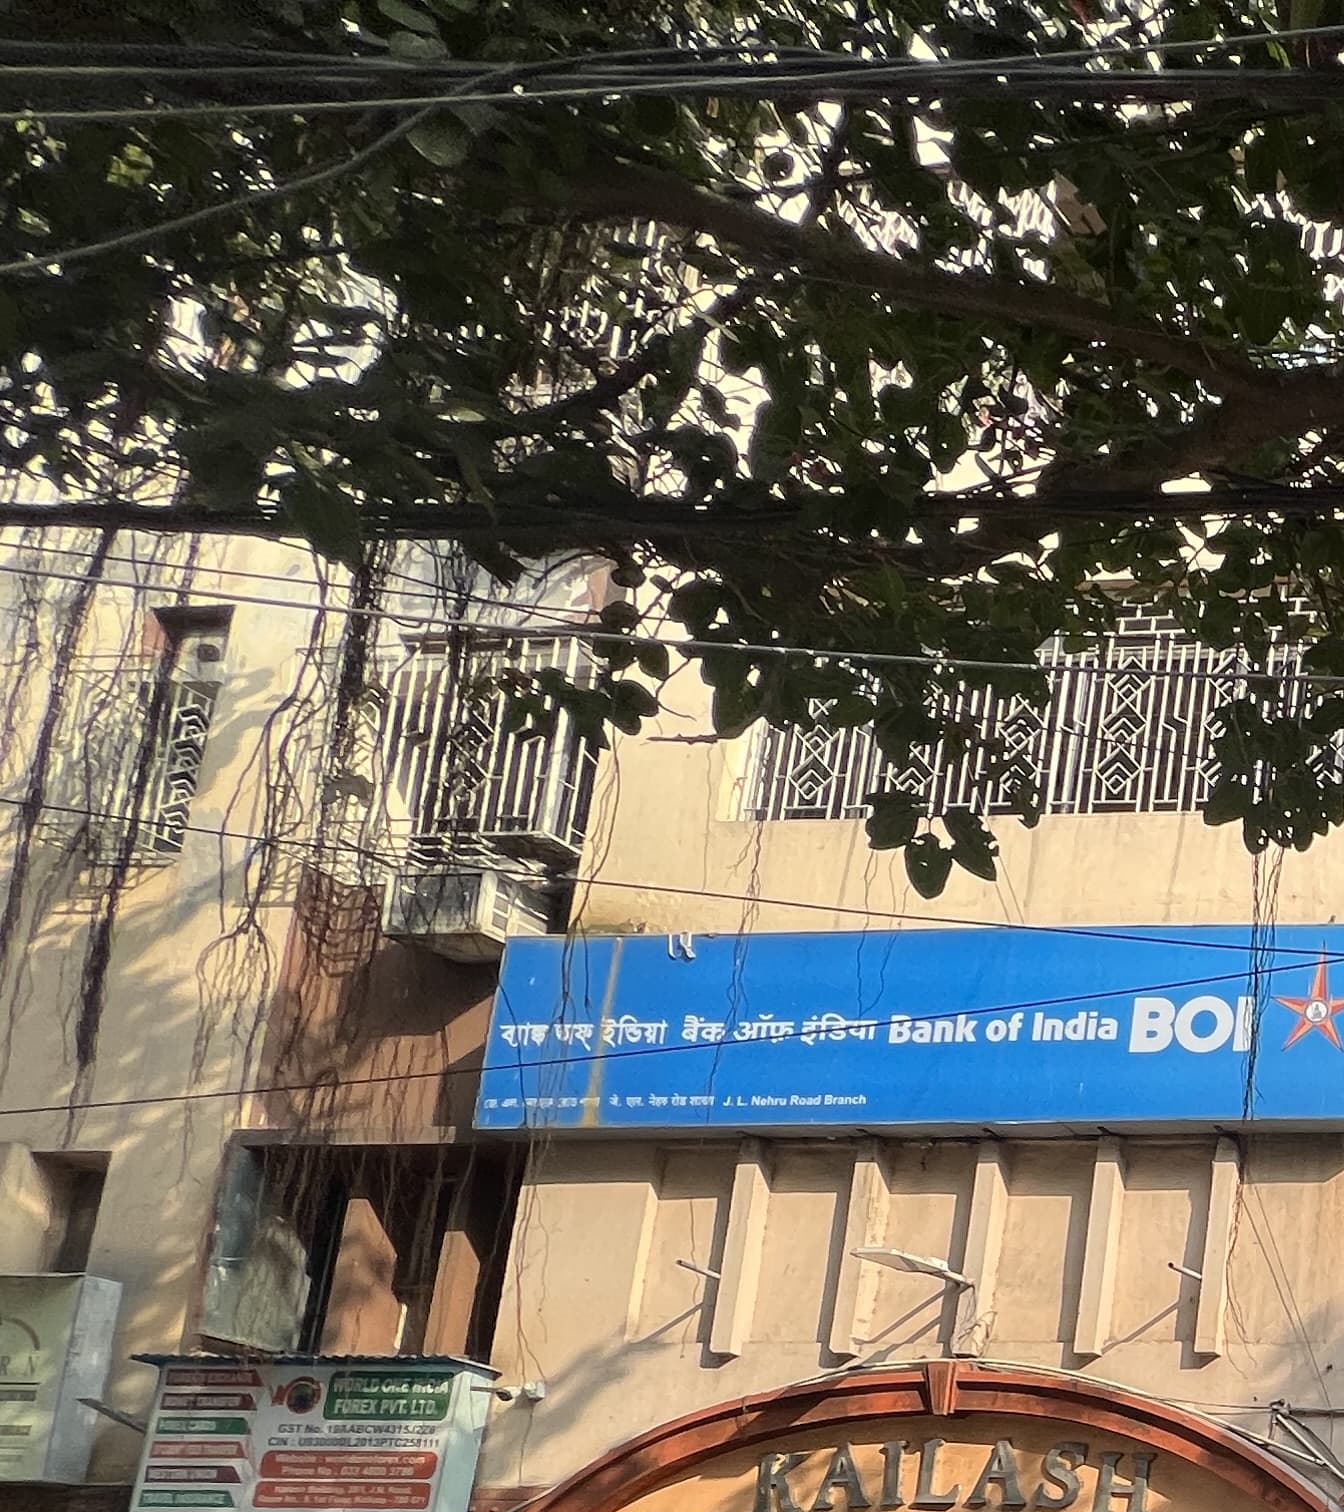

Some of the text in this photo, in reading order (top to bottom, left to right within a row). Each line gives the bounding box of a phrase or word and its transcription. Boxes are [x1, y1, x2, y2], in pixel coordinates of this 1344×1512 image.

[682, 1014, 725, 1043] बैंक
[800, 1013, 877, 1045] इंडिया
[888, 1010, 1118, 1044] Bank of India
[1128, 995, 1254, 1053] BOI
[752, 1095, 787, 1107] Nehru
[790, 1095, 821, 1106] Road
[824, 1094, 867, 1106] Branch
[334, 1378, 380, 1392] WORLD
[334, 1399, 378, 1414] FOREX
